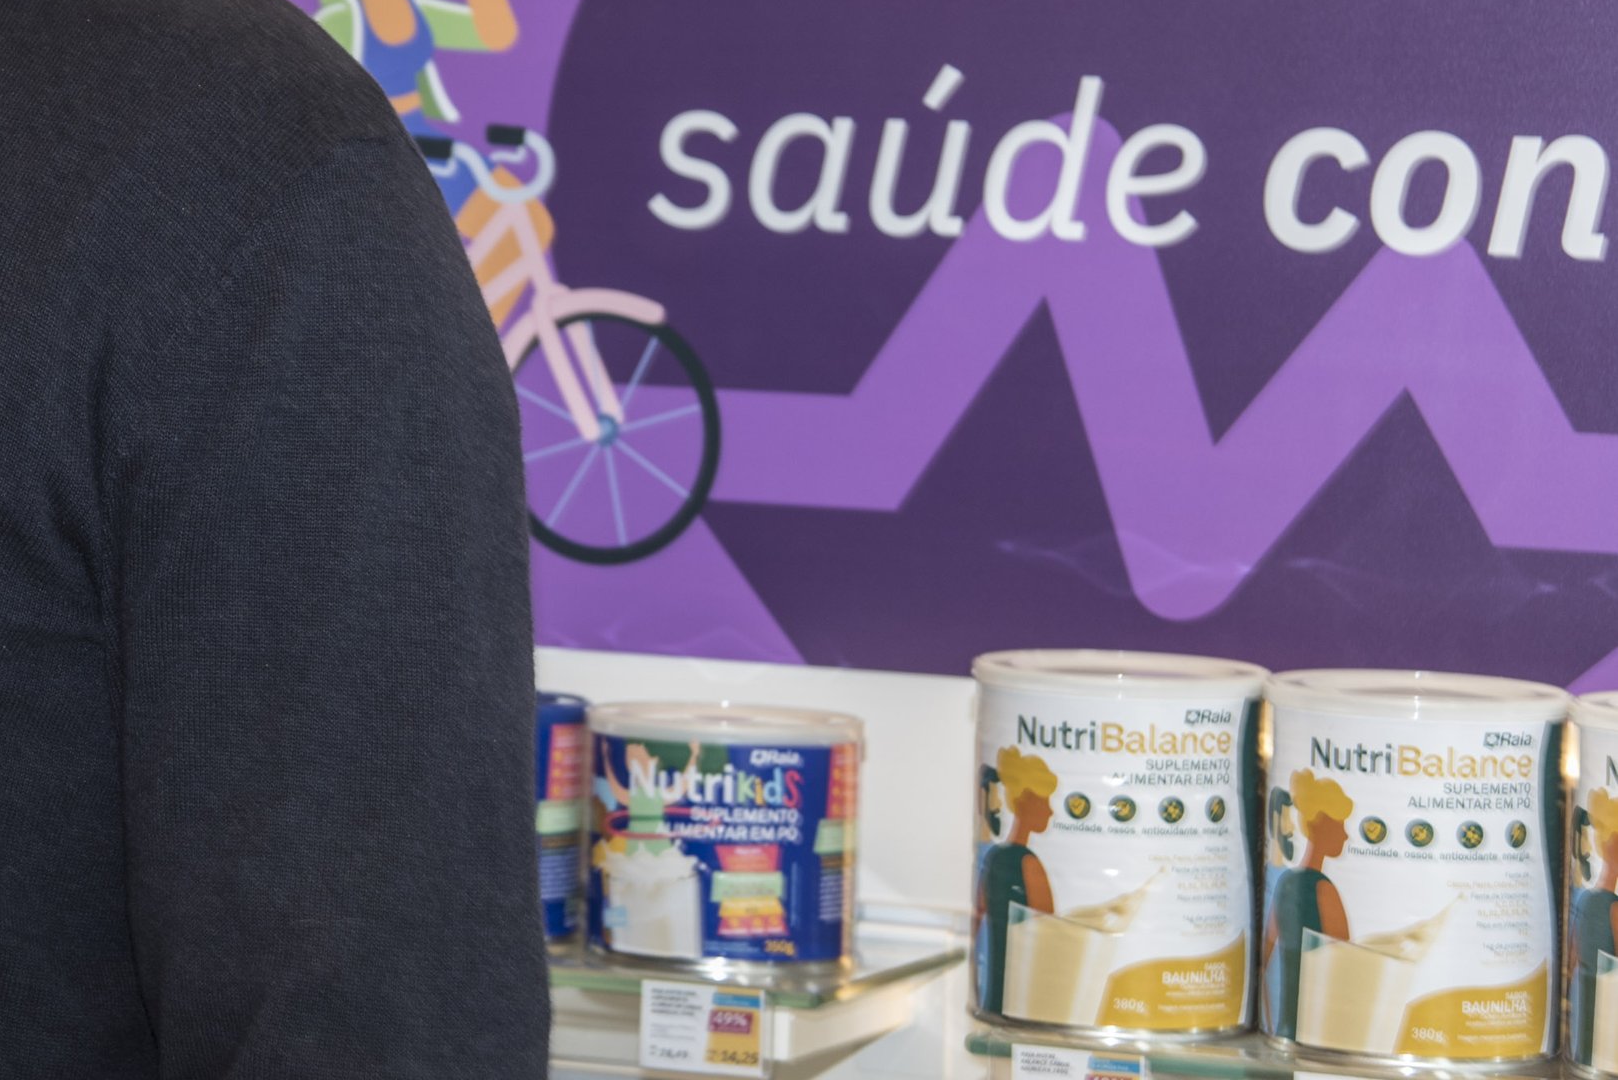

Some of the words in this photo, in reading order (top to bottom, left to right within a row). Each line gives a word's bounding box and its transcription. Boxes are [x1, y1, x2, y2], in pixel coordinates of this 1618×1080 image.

[647, 63, 1208, 248] saúde
[1262, 126, 1610, 262] con
[1201, 710, 1232, 725] Raia
[1017, 713, 1232, 755] NutriBalance
[1498, 731, 1533, 747] Raia
[1145, 758, 1232, 772] SUPLEMENTO
[1310, 735, 1533, 779] NutriBalance
[1195, 772, 1215, 786] EM
[1442, 781, 1532, 796] SUPLEMENTO
[1407, 795, 1493, 811] ALIMENTAR
[1494, 796, 1515, 810] EM
[689, 807, 799, 823] SUPLEMENTO
[655, 822, 747, 841] ALIMENTAR
[749, 824, 775, 841] EM
[1161, 969, 1227, 986] BAUNILHA
[1460, 1000, 1528, 1016] BAUNILHA
